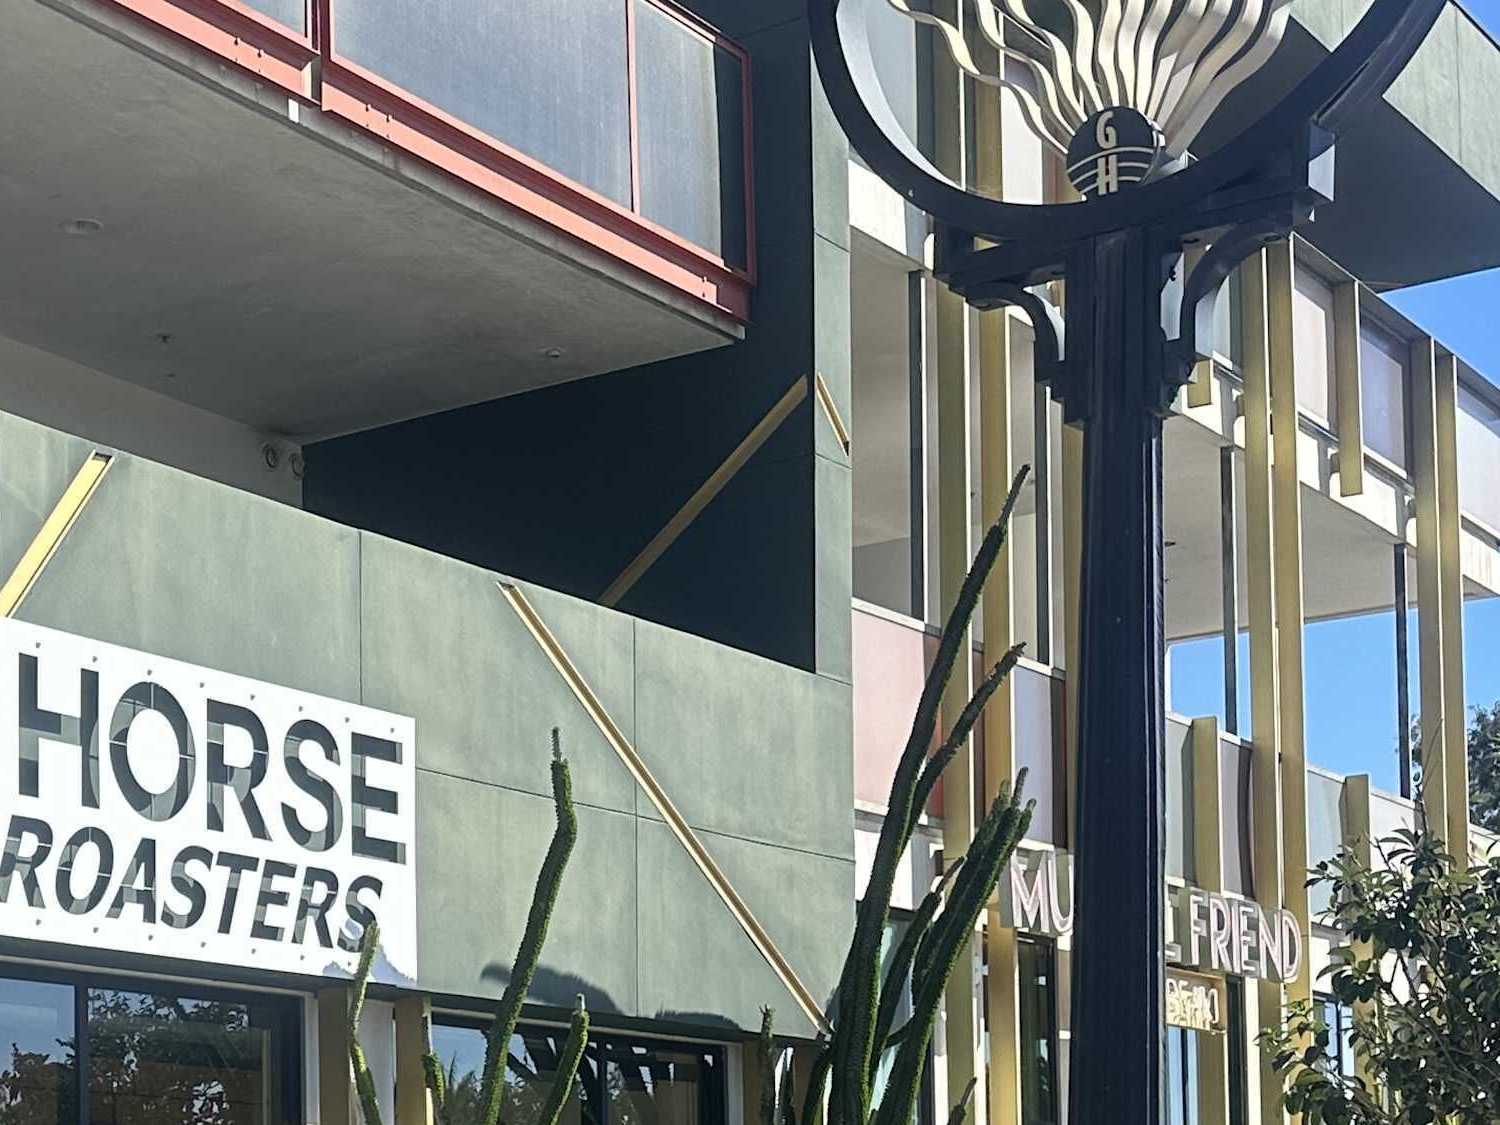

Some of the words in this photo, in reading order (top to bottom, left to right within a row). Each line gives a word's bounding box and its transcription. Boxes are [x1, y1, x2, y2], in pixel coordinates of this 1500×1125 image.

[1097, 111, 1118, 149] G
[1097, 152, 1119, 195] H
[18, 652, 407, 865] HORSE
[1010, 848, 1182, 962] MUL
[1190, 886, 1303, 984] FRIEND
